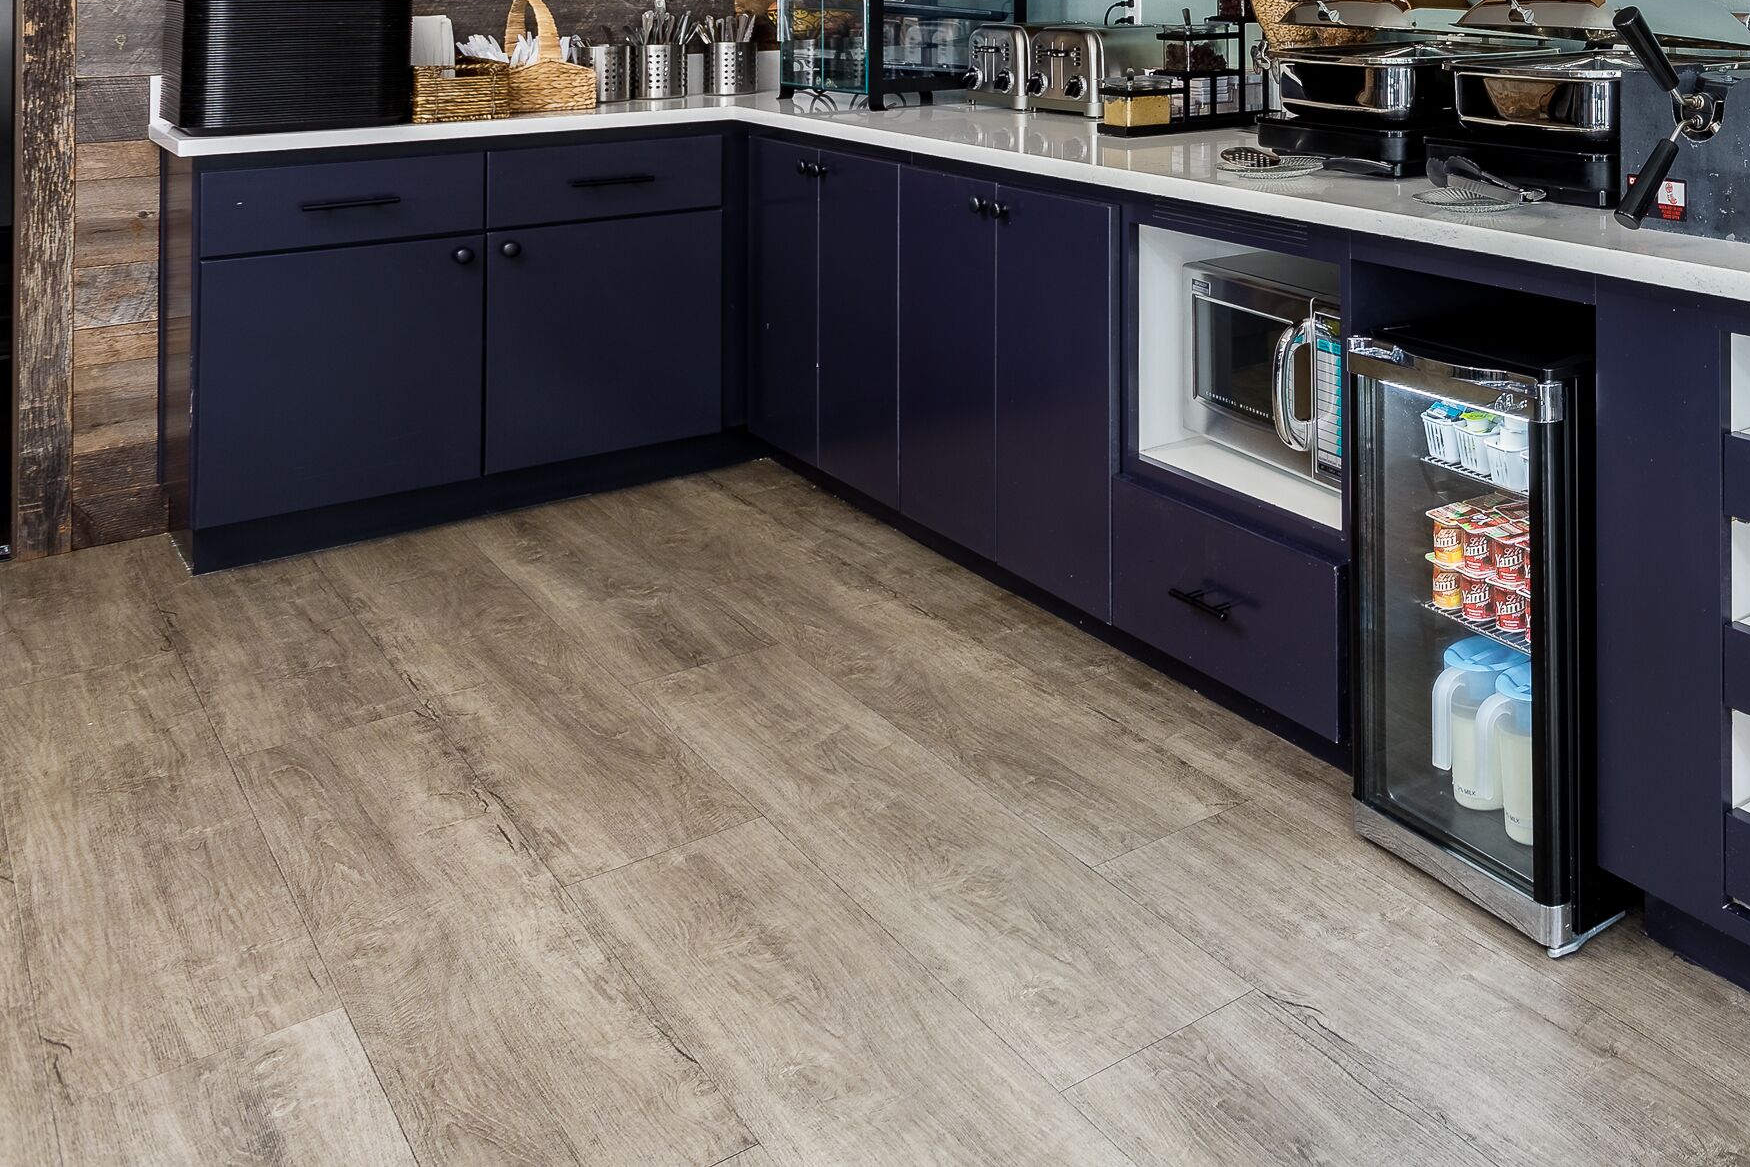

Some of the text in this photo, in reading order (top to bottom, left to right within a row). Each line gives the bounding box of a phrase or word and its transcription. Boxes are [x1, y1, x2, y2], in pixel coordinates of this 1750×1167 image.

[1494, 550, 1523, 568] Yami
[1462, 586, 1490, 604] Yami
[1495, 595, 1525, 615] Yami
